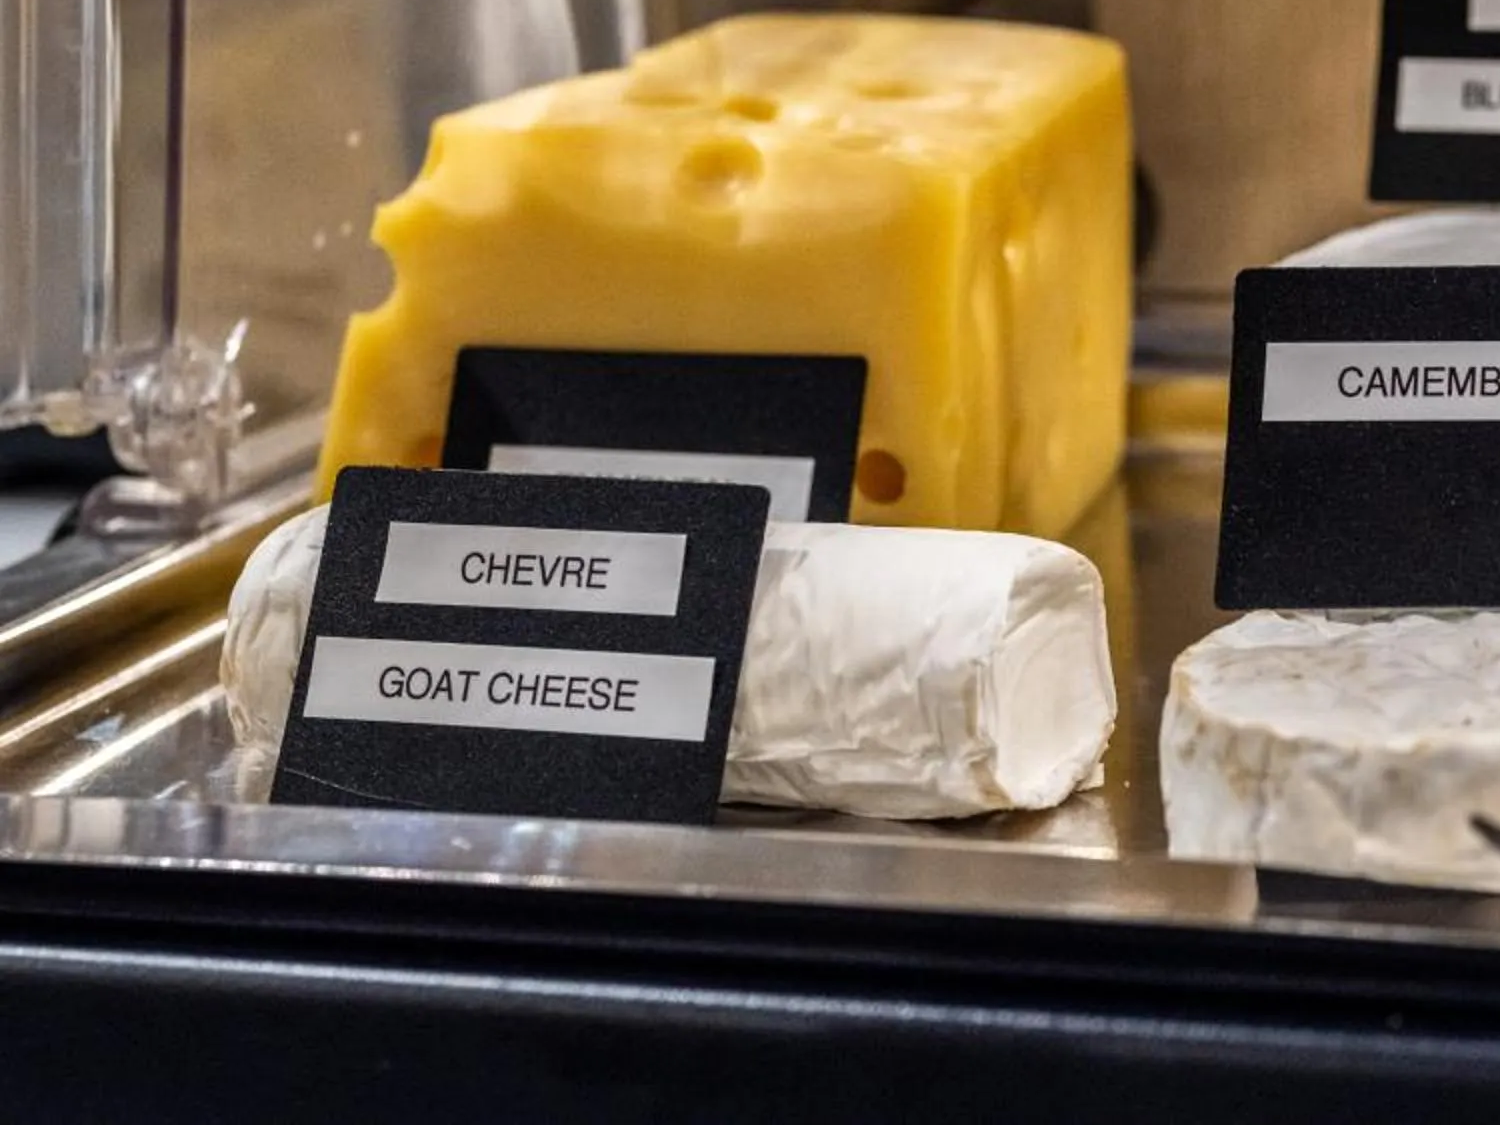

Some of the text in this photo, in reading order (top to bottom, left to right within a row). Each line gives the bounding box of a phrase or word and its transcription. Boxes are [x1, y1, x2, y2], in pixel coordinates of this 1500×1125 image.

[459, 551, 611, 590] CHEVRE
[377, 665, 640, 712] GOAT CHEESE
